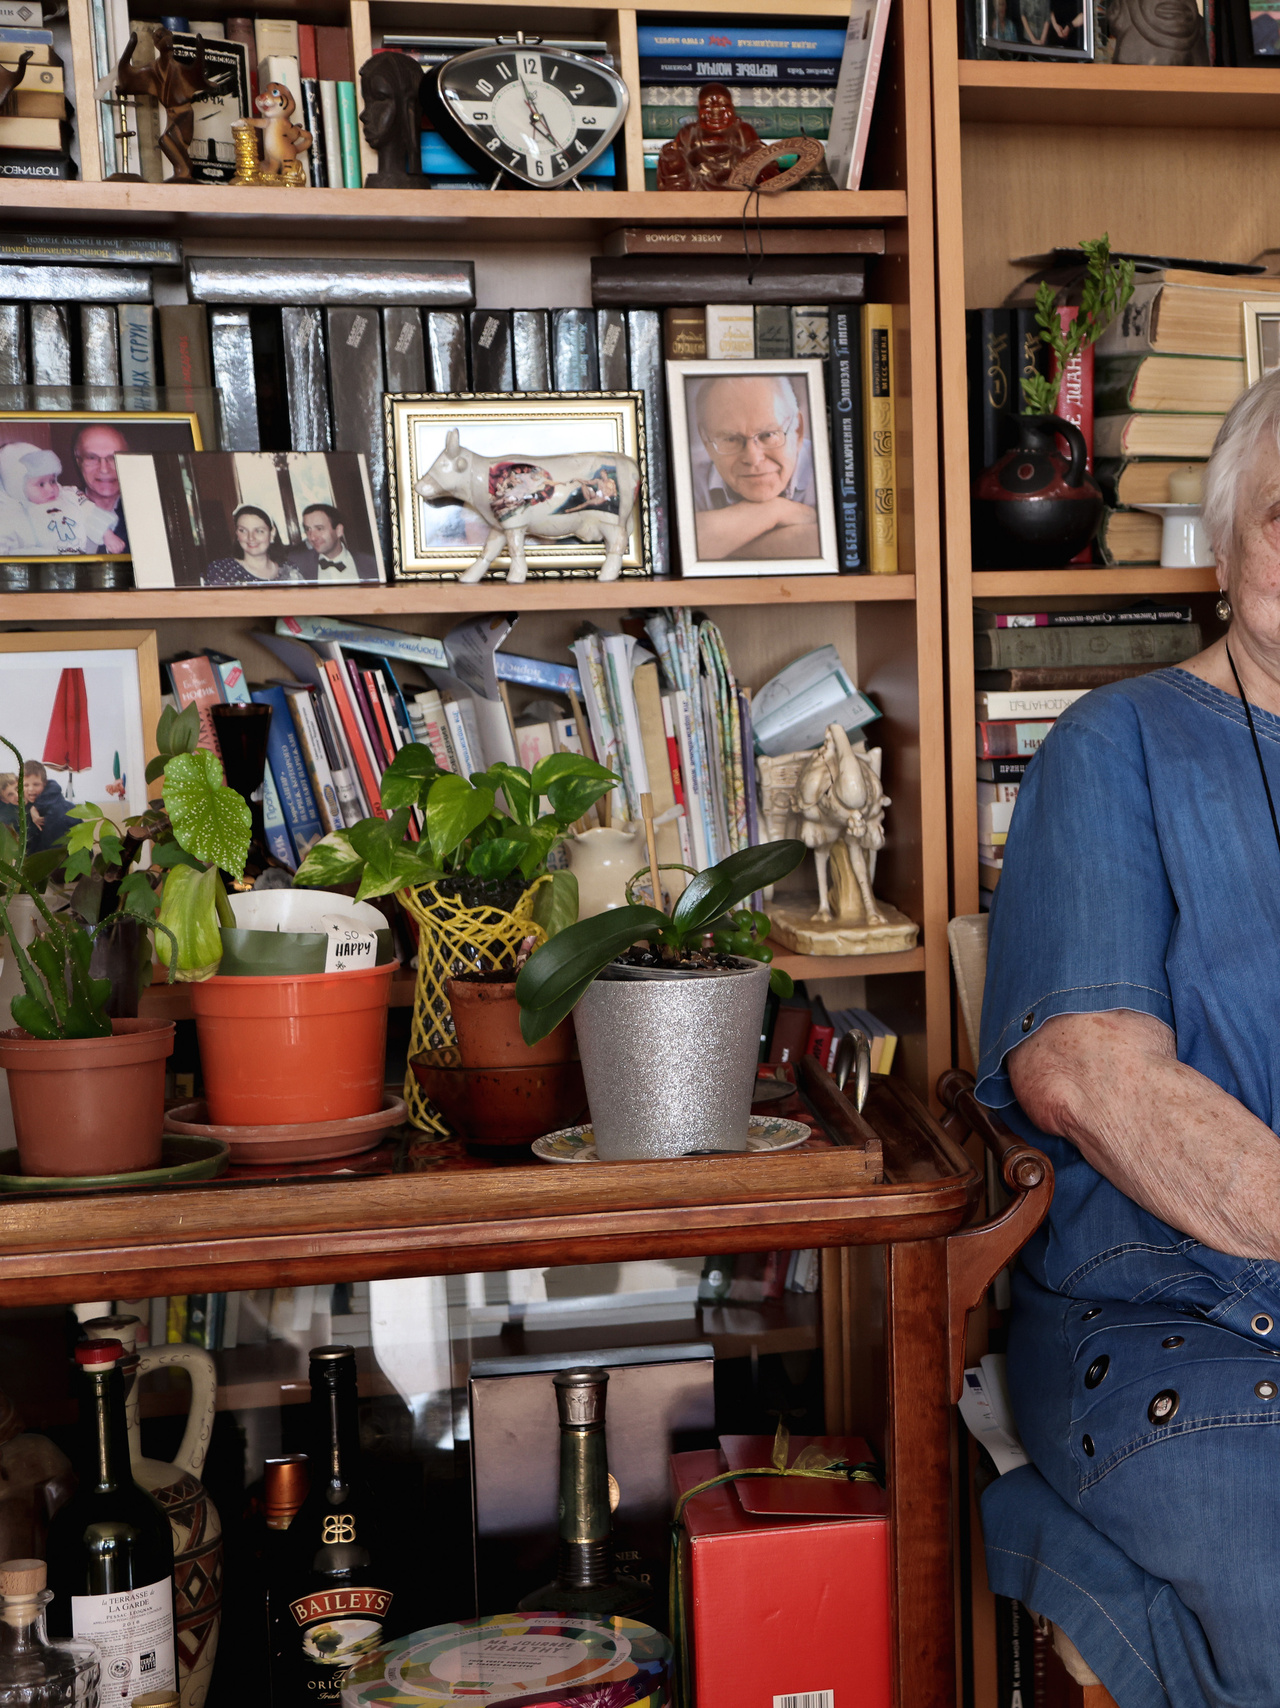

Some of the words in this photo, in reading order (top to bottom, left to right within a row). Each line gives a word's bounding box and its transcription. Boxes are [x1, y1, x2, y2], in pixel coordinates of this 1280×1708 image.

[495, 61, 510, 81] 11
[522, 57, 539, 75] 12
[549, 65, 559, 81] 1
[695, 61, 733, 77] МОЛЧАТ
[735, 62, 778, 77] МЕРТВЫЕ
[474, 77, 494, 98] 10
[572, 84, 586, 99] 2
[473, 111, 489, 122] 9
[582, 116, 596, 126] 3
[486, 137, 501, 152] 8
[575, 139, 588, 154] 4
[508, 152, 522, 168] 7
[534, 159, 545, 177] 6
[556, 152, 570, 170] 5
[0, 164, 60, 178] ПОЭТИЧЕСК
[645, 233, 687, 243] АЗИМОВ
[691, 234, 722, 244] АЙЗЕК
[125, 321, 149, 363] СТРУЙ
[880, 336, 889, 390] МЕСС-МЕНД
[1066, 348, 1084, 408] ДИАН
[310, 623, 361, 645] ПАРИЖА
[362, 633, 396, 648] вокруг
[397, 641, 446, 662] Прогулки
[181, 685, 215, 702] НОСИК
[458, 723, 475, 776] поразительн
[999, 764, 1027, 774] ПРИНЦ
[344, 928, 360, 942] SO
[335, 940, 372, 957] HAPPY
[108, 1590, 149, 1604] TERRASSE
[108, 1604, 121, 1613] LA
[121, 1598, 150, 1610] GARDE
[293, 1591, 387, 1621] BAILEYS
[1013, 1659, 1021, 1678] вам
